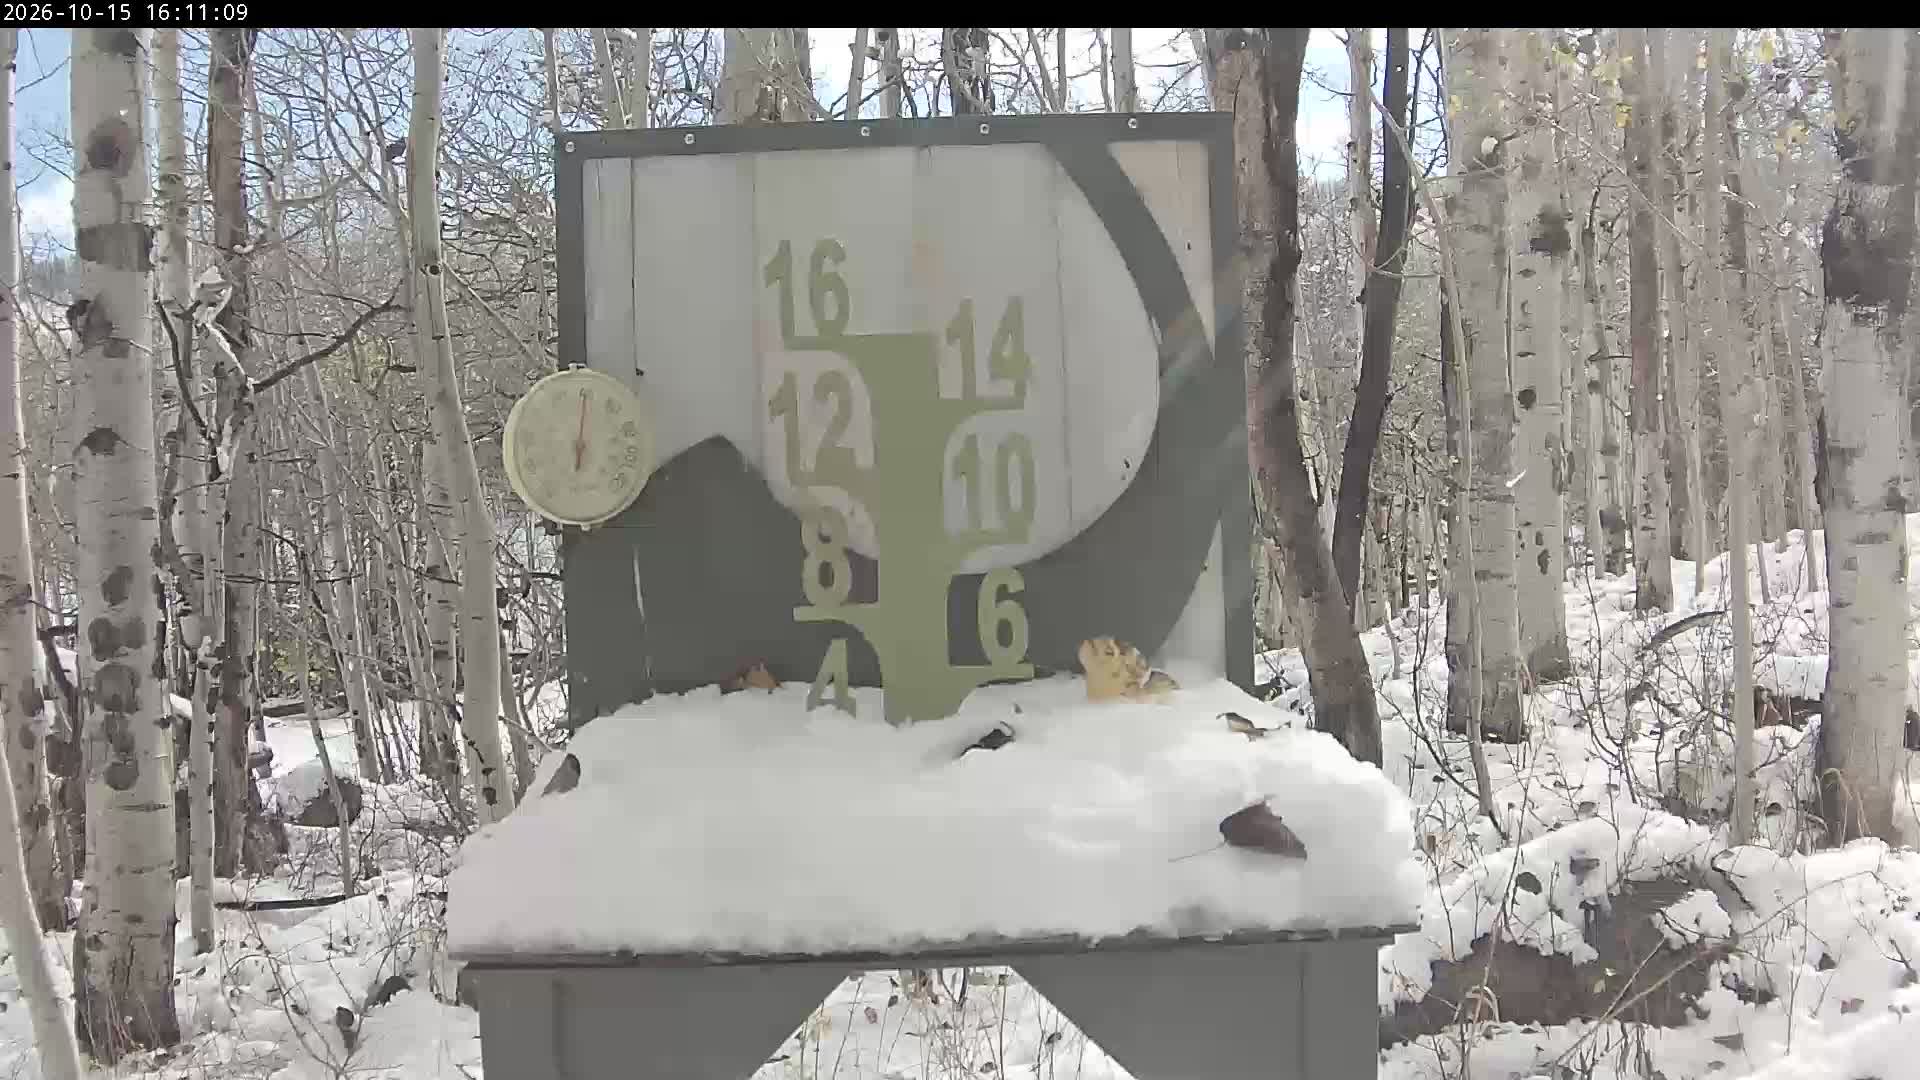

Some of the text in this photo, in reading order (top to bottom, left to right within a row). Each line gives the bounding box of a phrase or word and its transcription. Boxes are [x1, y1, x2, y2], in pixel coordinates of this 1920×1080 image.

[764, 235, 850, 340] 16
[946, 296, 1034, 402] 14
[768, 369, 853, 485] 12
[952, 432, 1036, 538] 10
[801, 505, 851, 606] 8
[978, 566, 1029, 668] 6
[806, 638, 857, 716] 4
